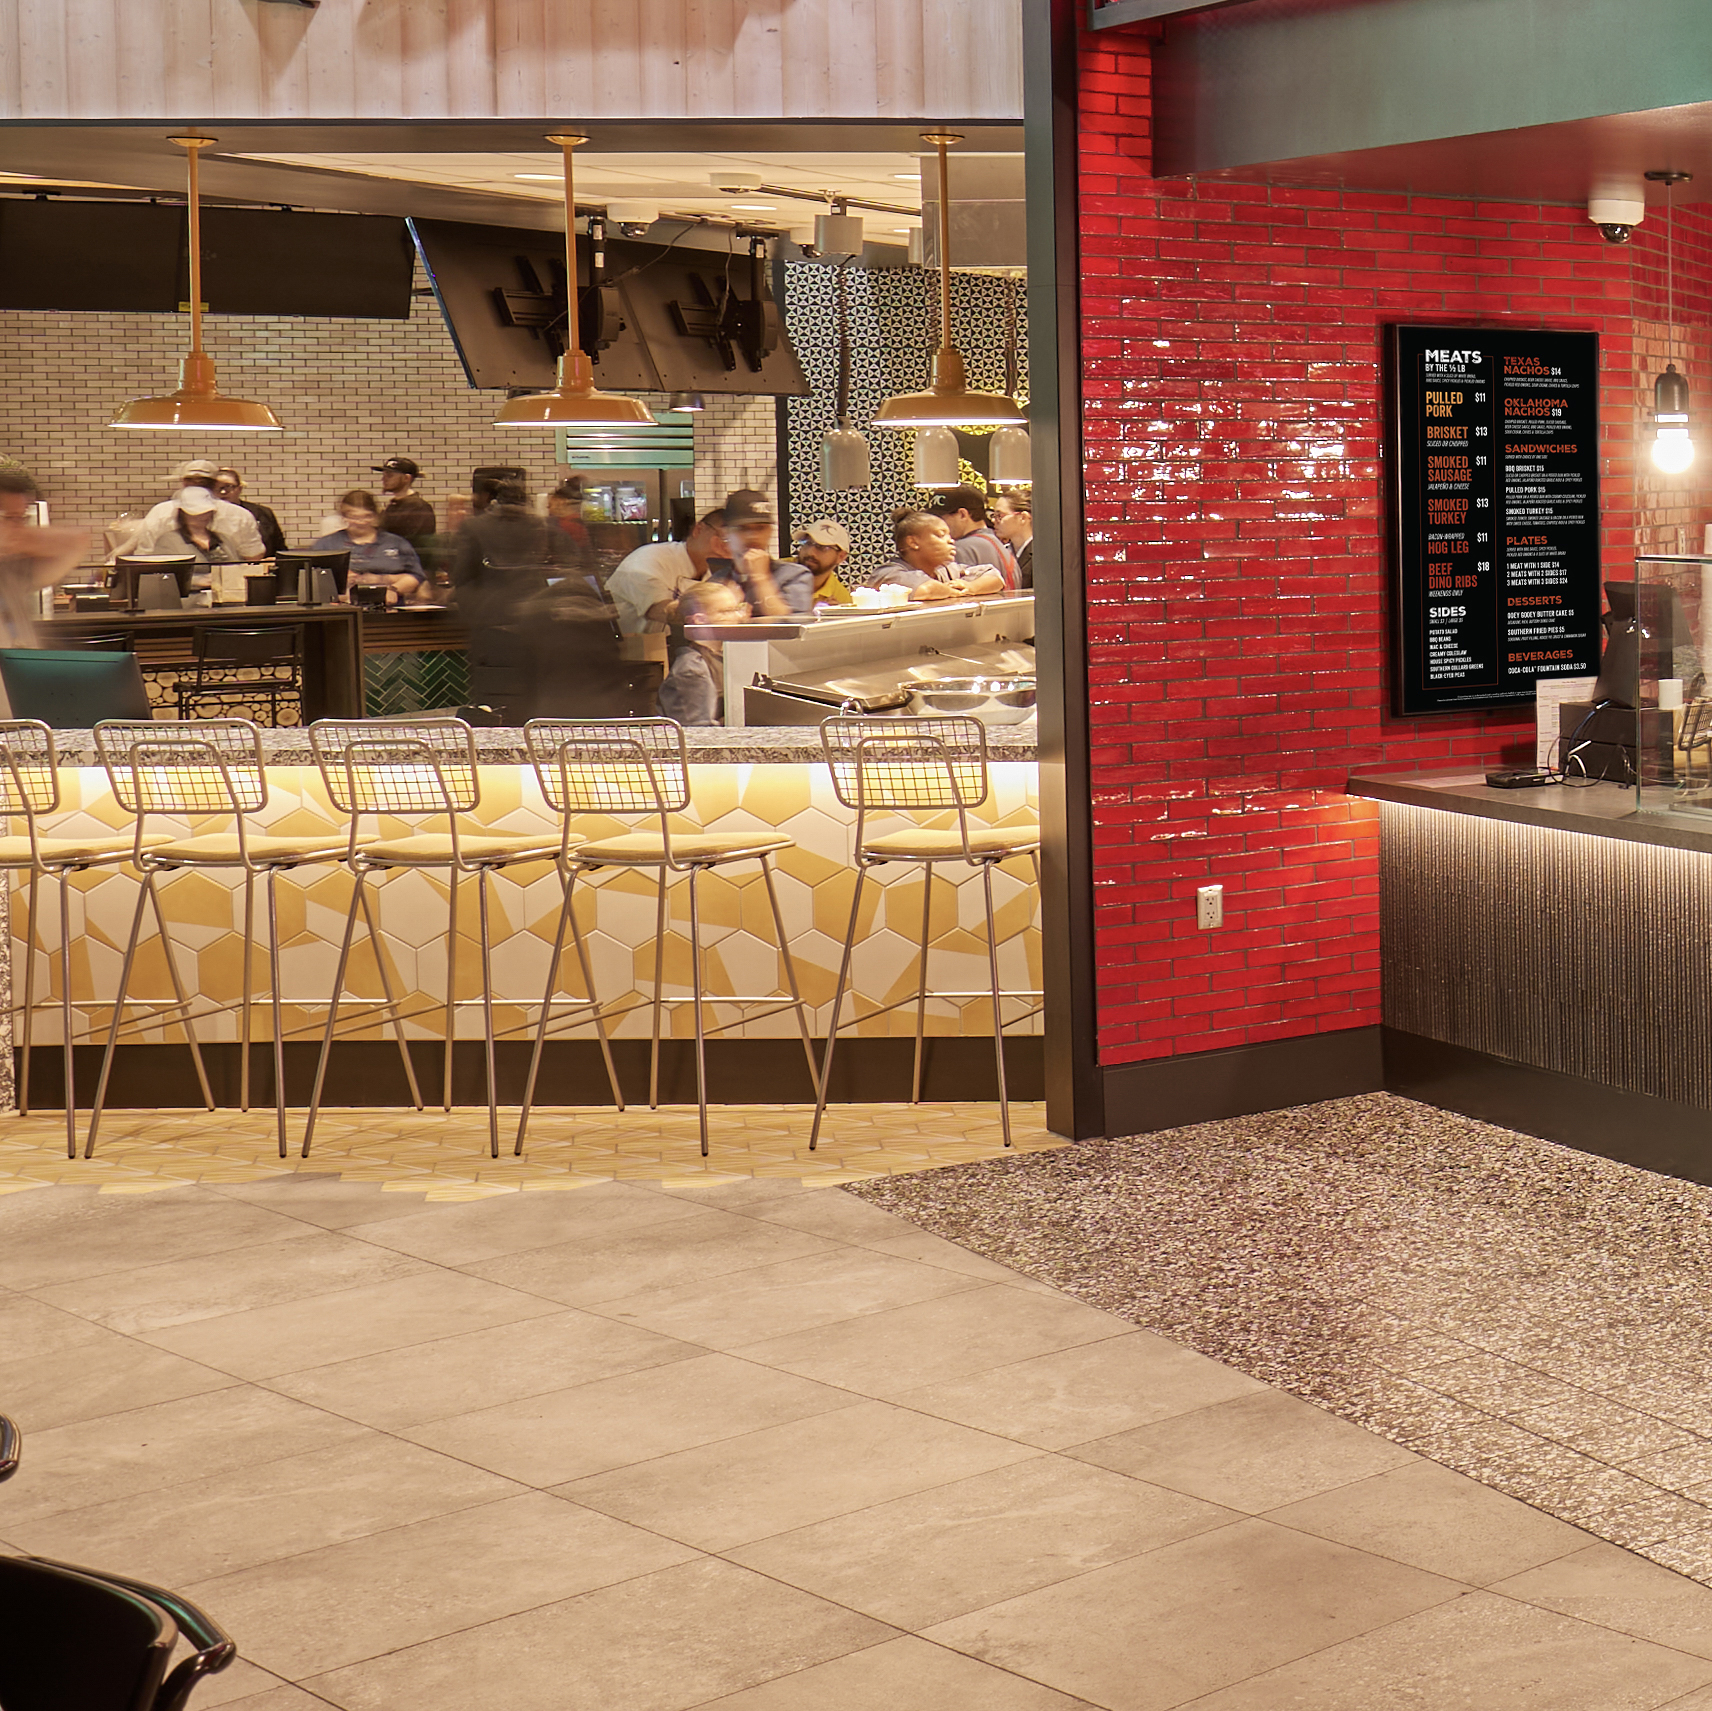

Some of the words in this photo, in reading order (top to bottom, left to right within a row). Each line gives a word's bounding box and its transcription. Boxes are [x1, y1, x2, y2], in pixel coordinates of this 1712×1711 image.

[1425, 349, 1482, 364] MEATS
[1503, 356, 1540, 366] TEXAS
[1424, 363, 1434, 372] BY
[1434, 363, 1448, 372] THE
[1457, 364, 1466, 373] LB
[1503, 365, 1550, 375] NACHOS
[1550, 366, 1561, 376] $14
[1425, 391, 1463, 404] PULLED
[1474, 391, 1486, 403] $11
[1504, 397, 1568, 408] OKLAHOMA
[1426, 404, 1453, 417] PORK
[1504, 406, 1550, 416] NACHOS
[1551, 408, 1562, 417] $19
[1427, 425, 1468, 439] BRISKET
[1475, 426, 1488, 437] $13
[1505, 444, 1578, 453] SANDWICHES
[1427, 455, 1468, 468] SMOKED
[1475, 455, 1487, 466] $11
[1427, 468, 1472, 482] SAUSAGE
[1427, 498, 1469, 511] SMOKED
[1476, 497, 1489, 508] $13
[1427, 511, 1467, 525] TURKEY
[1476, 532, 1488, 543] $11
[1506, 535, 1548, 545] PLATES
[1428, 541, 1448, 554] HOG
[1451, 540, 1469, 553] LEG
[1428, 562, 1453, 576] BEEF
[1477, 561, 1490, 572] $18
[1428, 575, 1452, 589] DINO
[1455, 574, 1478, 588] RIBS
[1507, 595, 1562, 606] DESSERTS
[1429, 605, 1466, 618] SIDES
[1508, 649, 1573, 662] BEVERAGES
